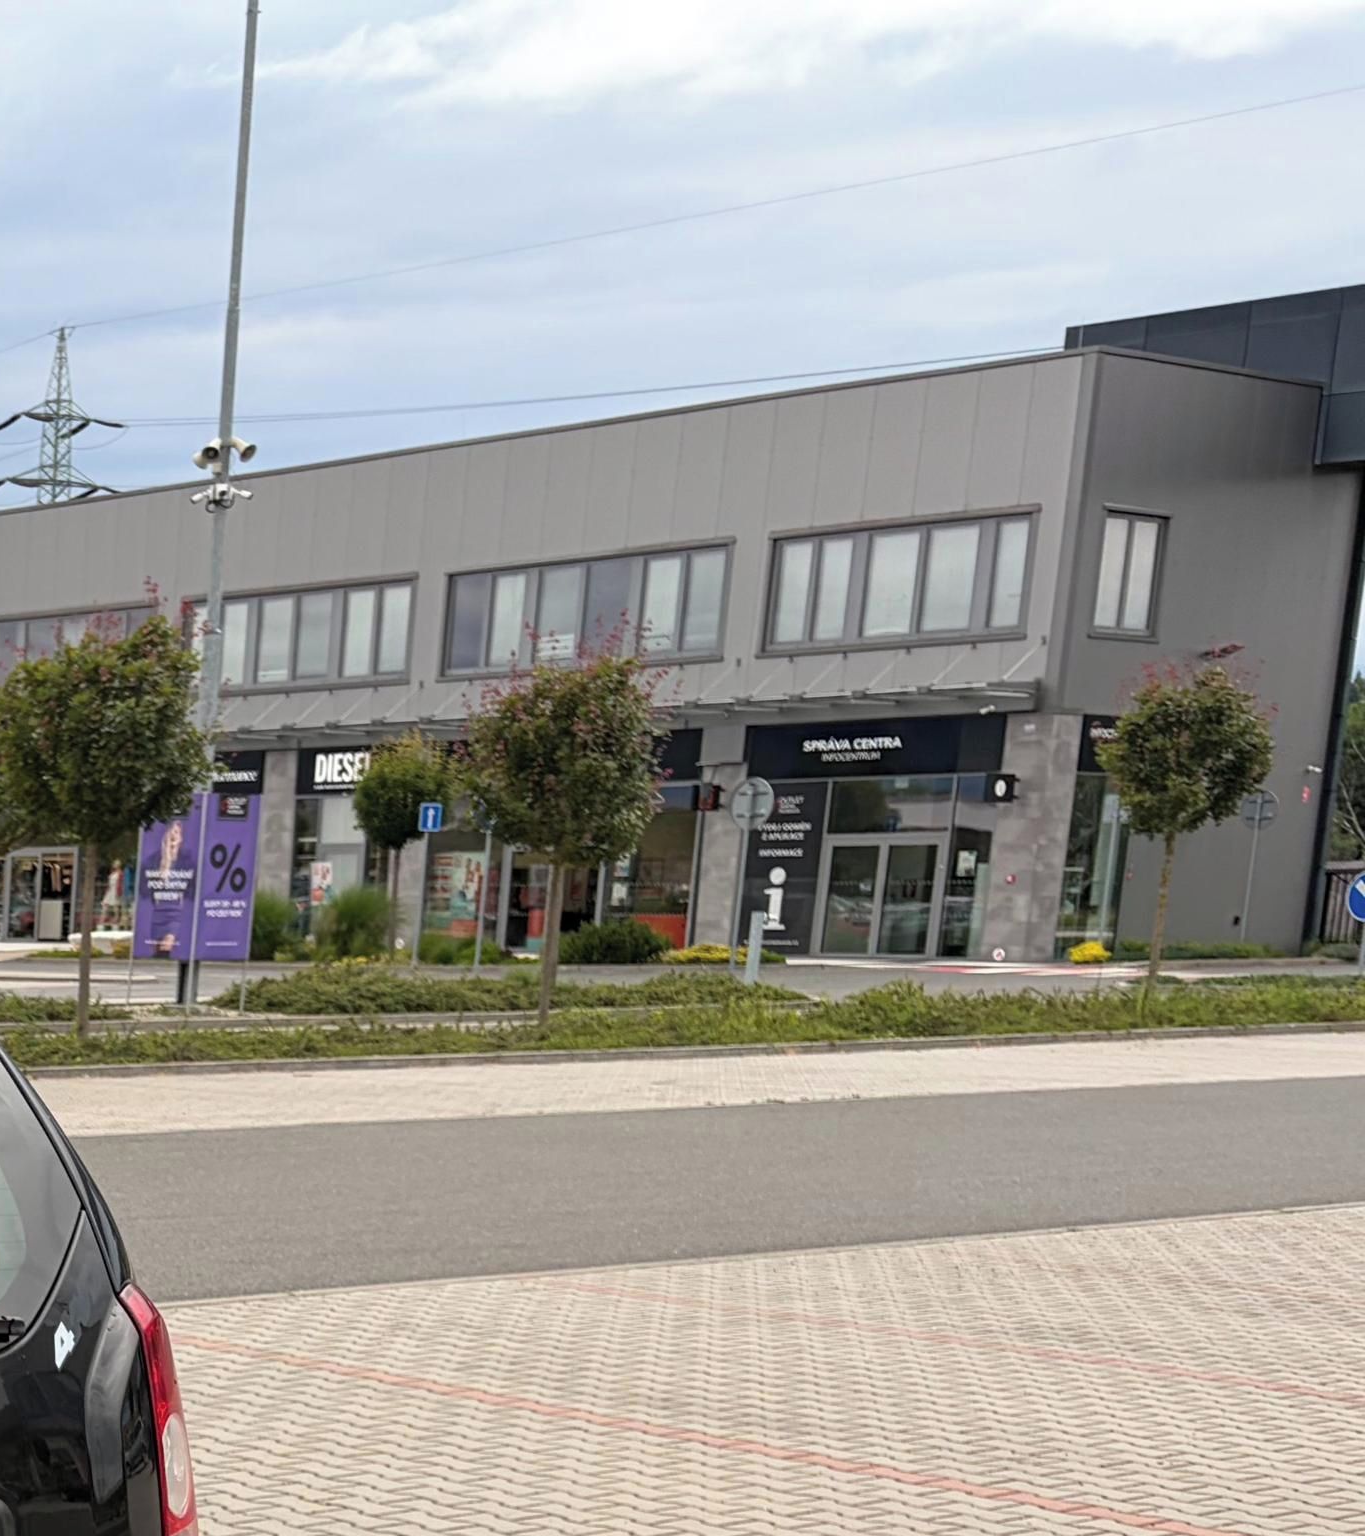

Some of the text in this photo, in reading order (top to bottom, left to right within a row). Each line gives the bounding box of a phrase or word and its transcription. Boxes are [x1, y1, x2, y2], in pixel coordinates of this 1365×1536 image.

[802, 735, 903, 752] SPRÁVA CENTRA
[821, 751, 881, 762] INFOCENTRUM
